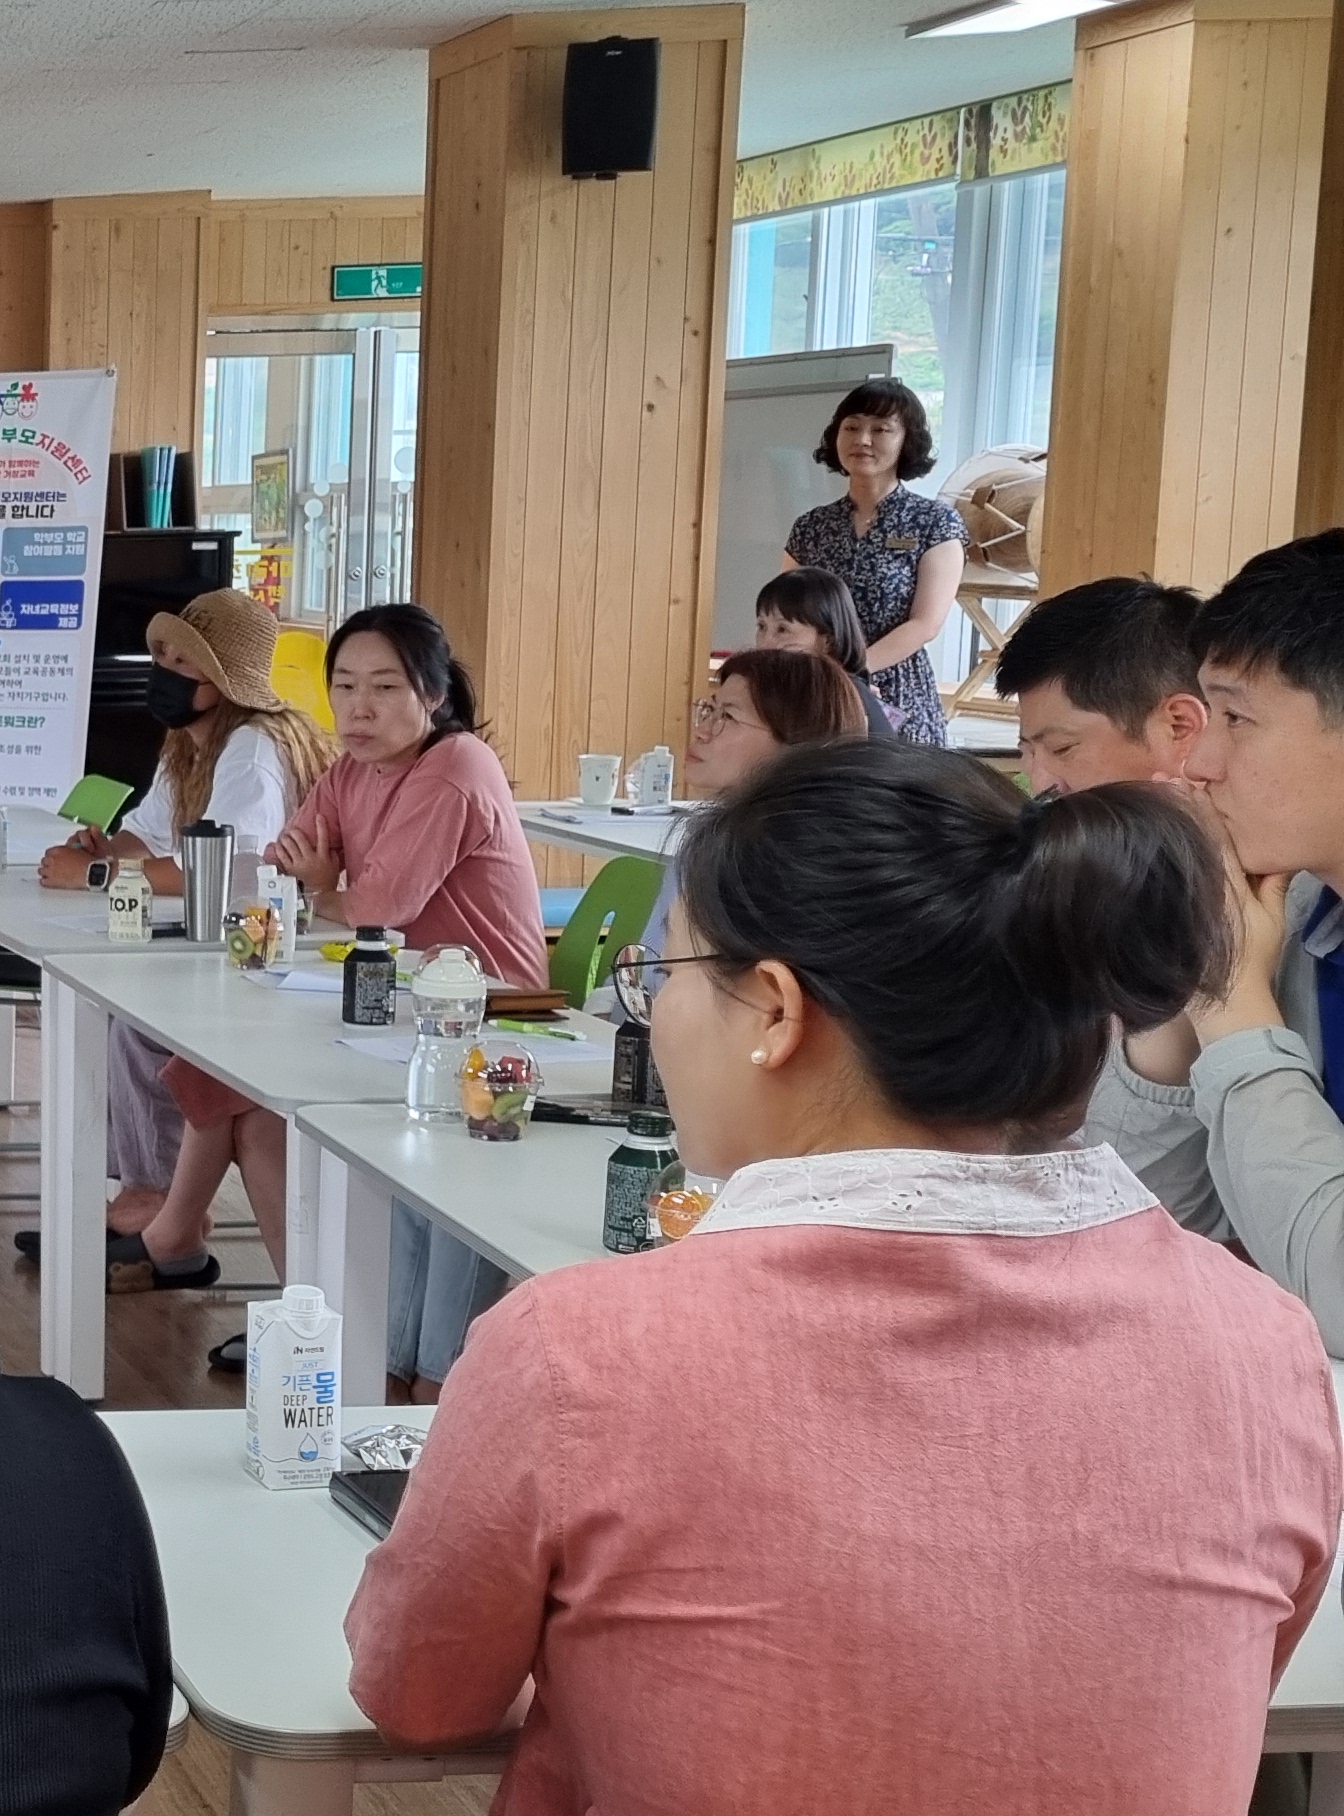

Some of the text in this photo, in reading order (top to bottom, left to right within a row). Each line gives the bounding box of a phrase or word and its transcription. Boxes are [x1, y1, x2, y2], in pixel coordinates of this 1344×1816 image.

[11, 504, 56, 519] 합니다
[283, 1394, 308, 1407] DEEP
[283, 1406, 334, 1429] WATER
